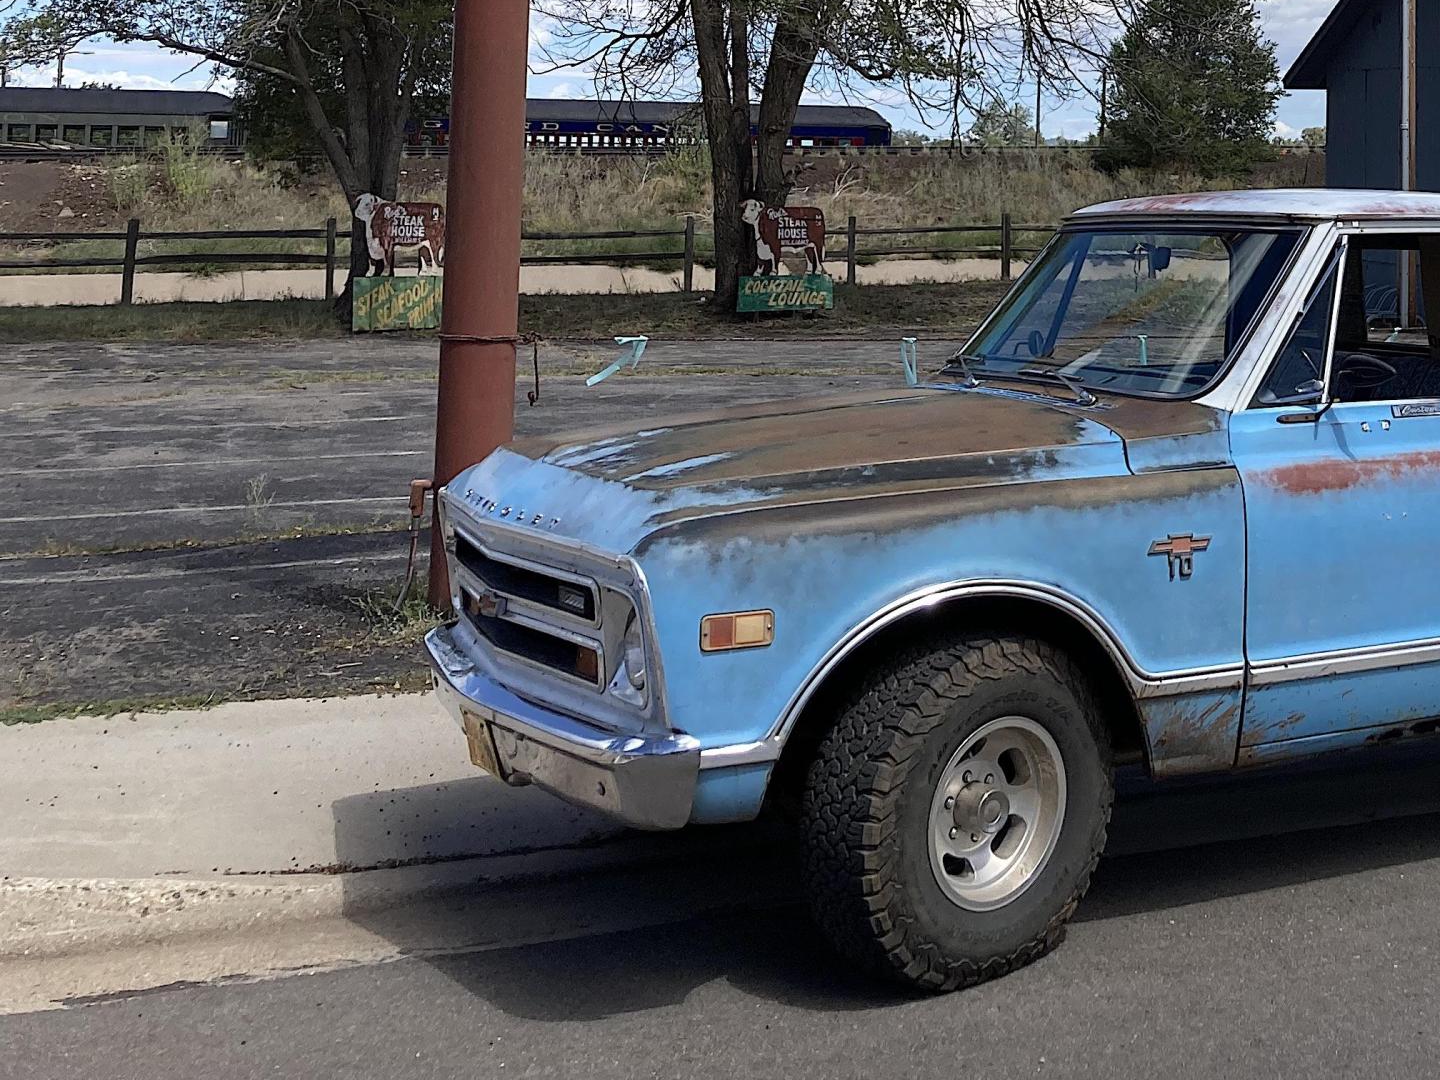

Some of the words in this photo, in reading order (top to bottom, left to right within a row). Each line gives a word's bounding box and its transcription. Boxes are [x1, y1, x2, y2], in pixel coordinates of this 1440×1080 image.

[392, 216, 424, 226] STEAK
[778, 217, 808, 227] STEAK
[390, 226, 426, 237] HOUSE
[777, 228, 808, 239] HOUSE
[744, 279, 805, 295] COCKTAIL
[358, 279, 395, 316] STEAK
[376, 280, 429, 328] SEAFOOD
[767, 291, 827, 306] LOUNGE
